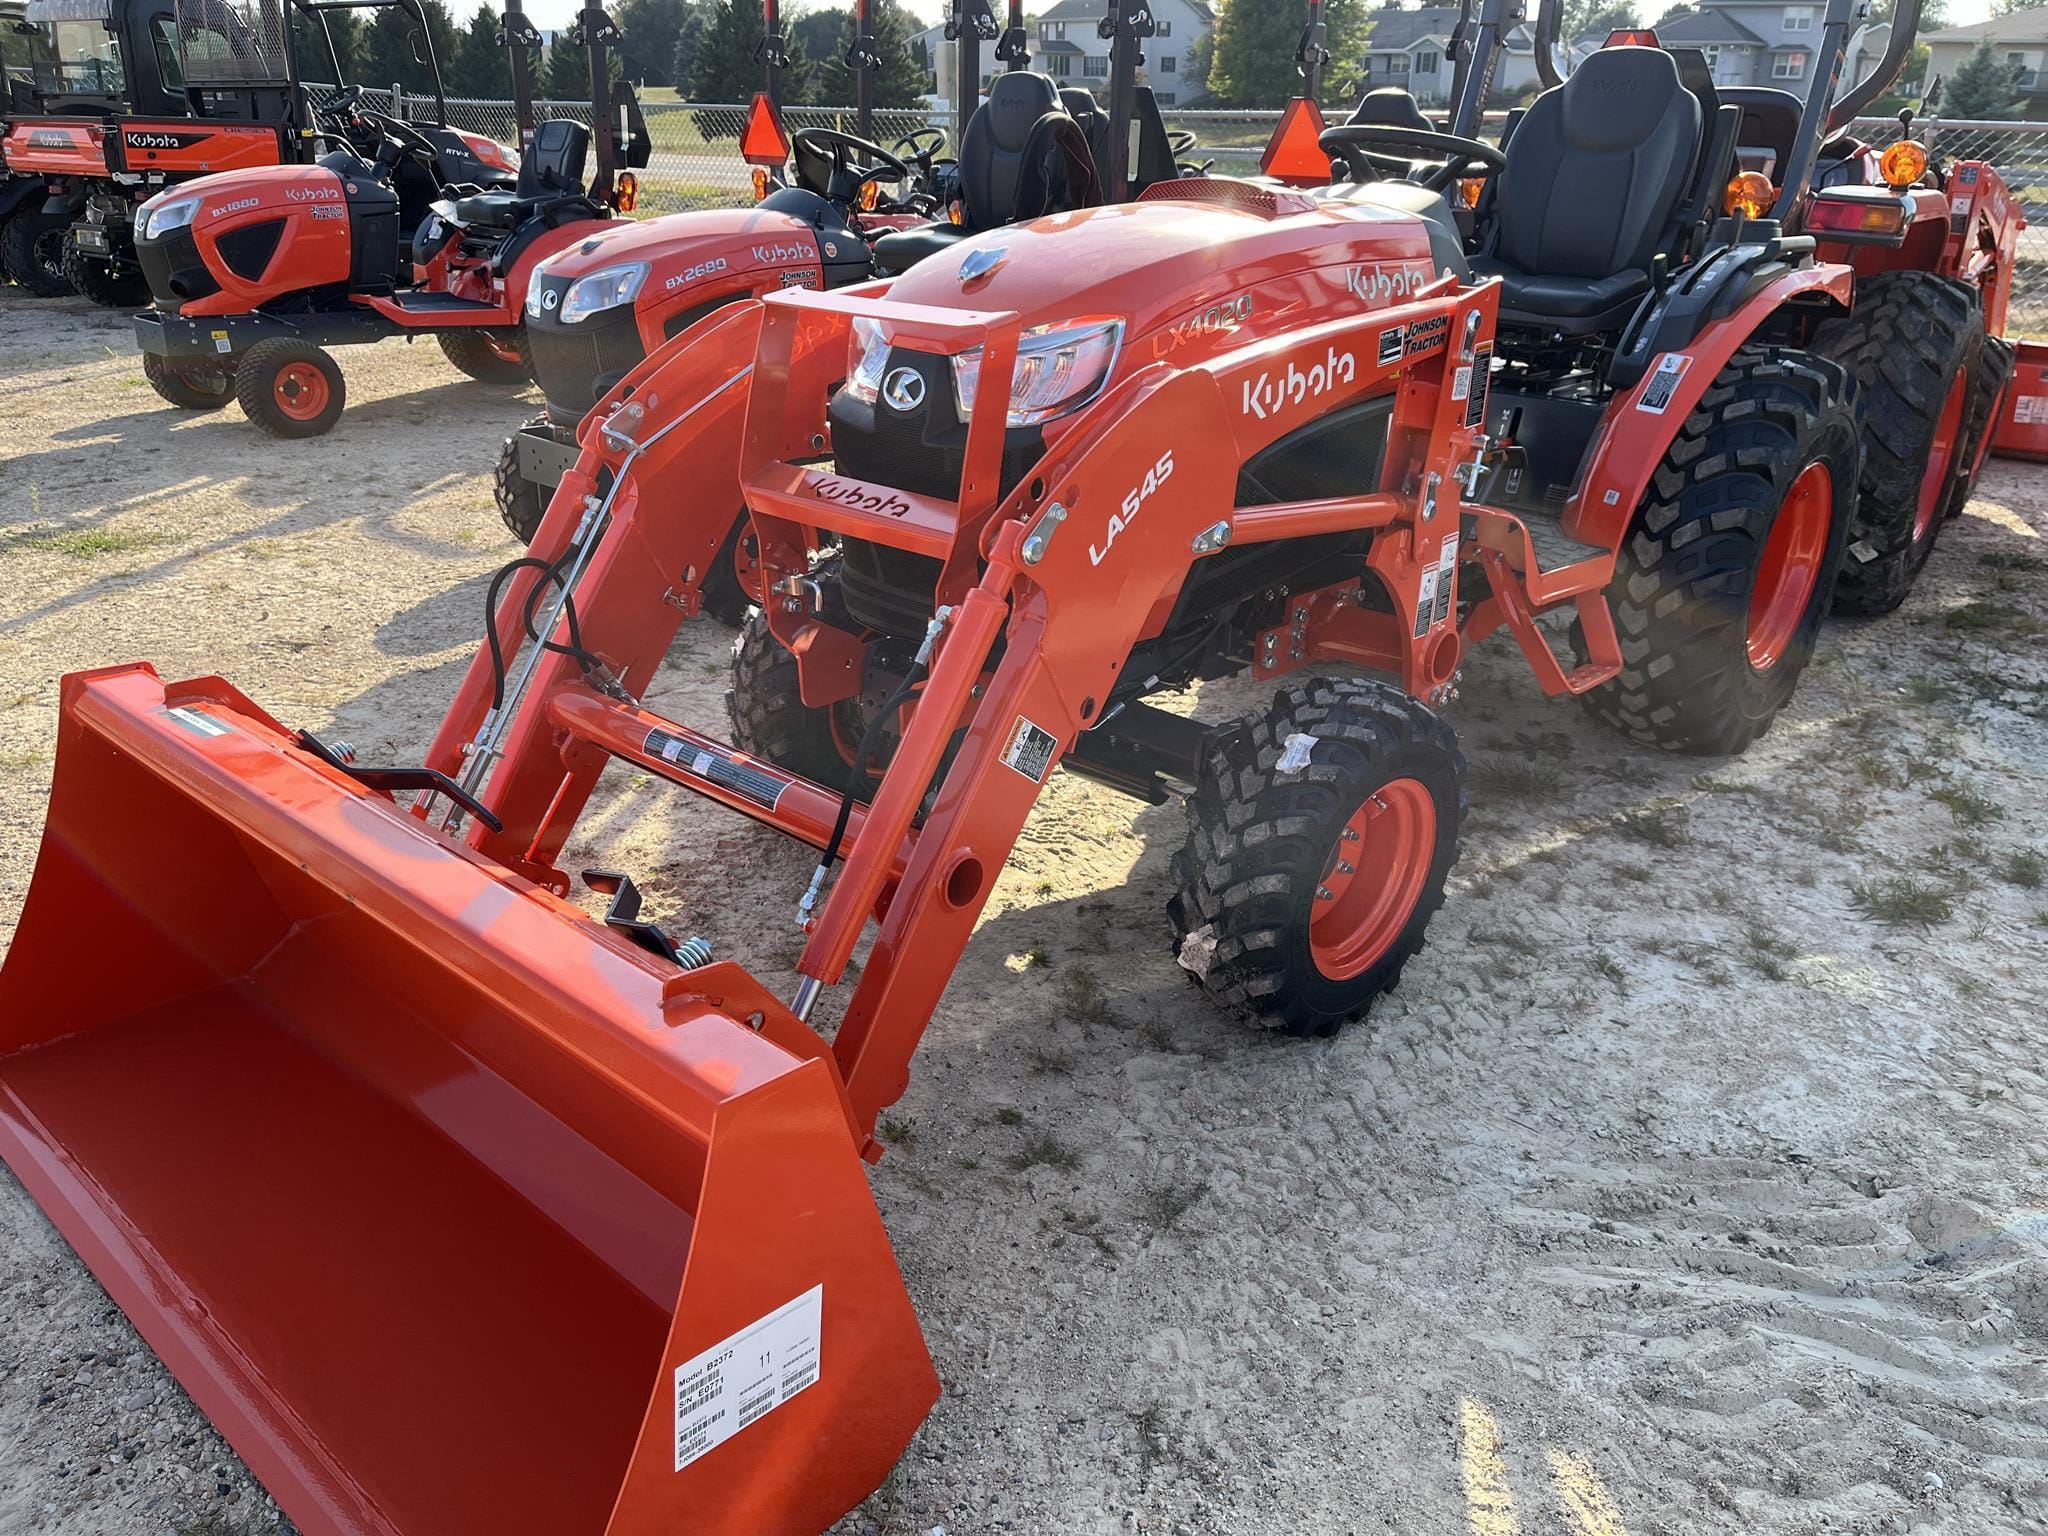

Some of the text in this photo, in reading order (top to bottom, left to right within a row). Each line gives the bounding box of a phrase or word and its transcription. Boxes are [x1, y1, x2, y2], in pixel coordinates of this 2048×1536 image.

[127, 133, 179, 147] Kubota
[446, 148, 469, 158] RTV-X
[285, 187, 340, 201] Kubota
[212, 197, 260, 217] BX1880
[751, 241, 816, 263] Kubota
[665, 257, 727, 290] BX2680
[780, 270, 816, 281] JOHNSON
[1345, 263, 1425, 300] Kubota
[1152, 294, 1252, 359] LX4020
[1404, 314, 1449, 339] JOHNSON
[1403, 332, 1447, 356] TRACTOR
[1242, 346, 1355, 419] Kubota
[808, 477, 911, 518] Kubota
[1088, 449, 1174, 567] LA545
[678, 1349, 733, 1387] Model B2372
[759, 1350, 770, 1368] 11
[678, 1396, 693, 1409] S/N
[698, 1376, 724, 1397] E0771
